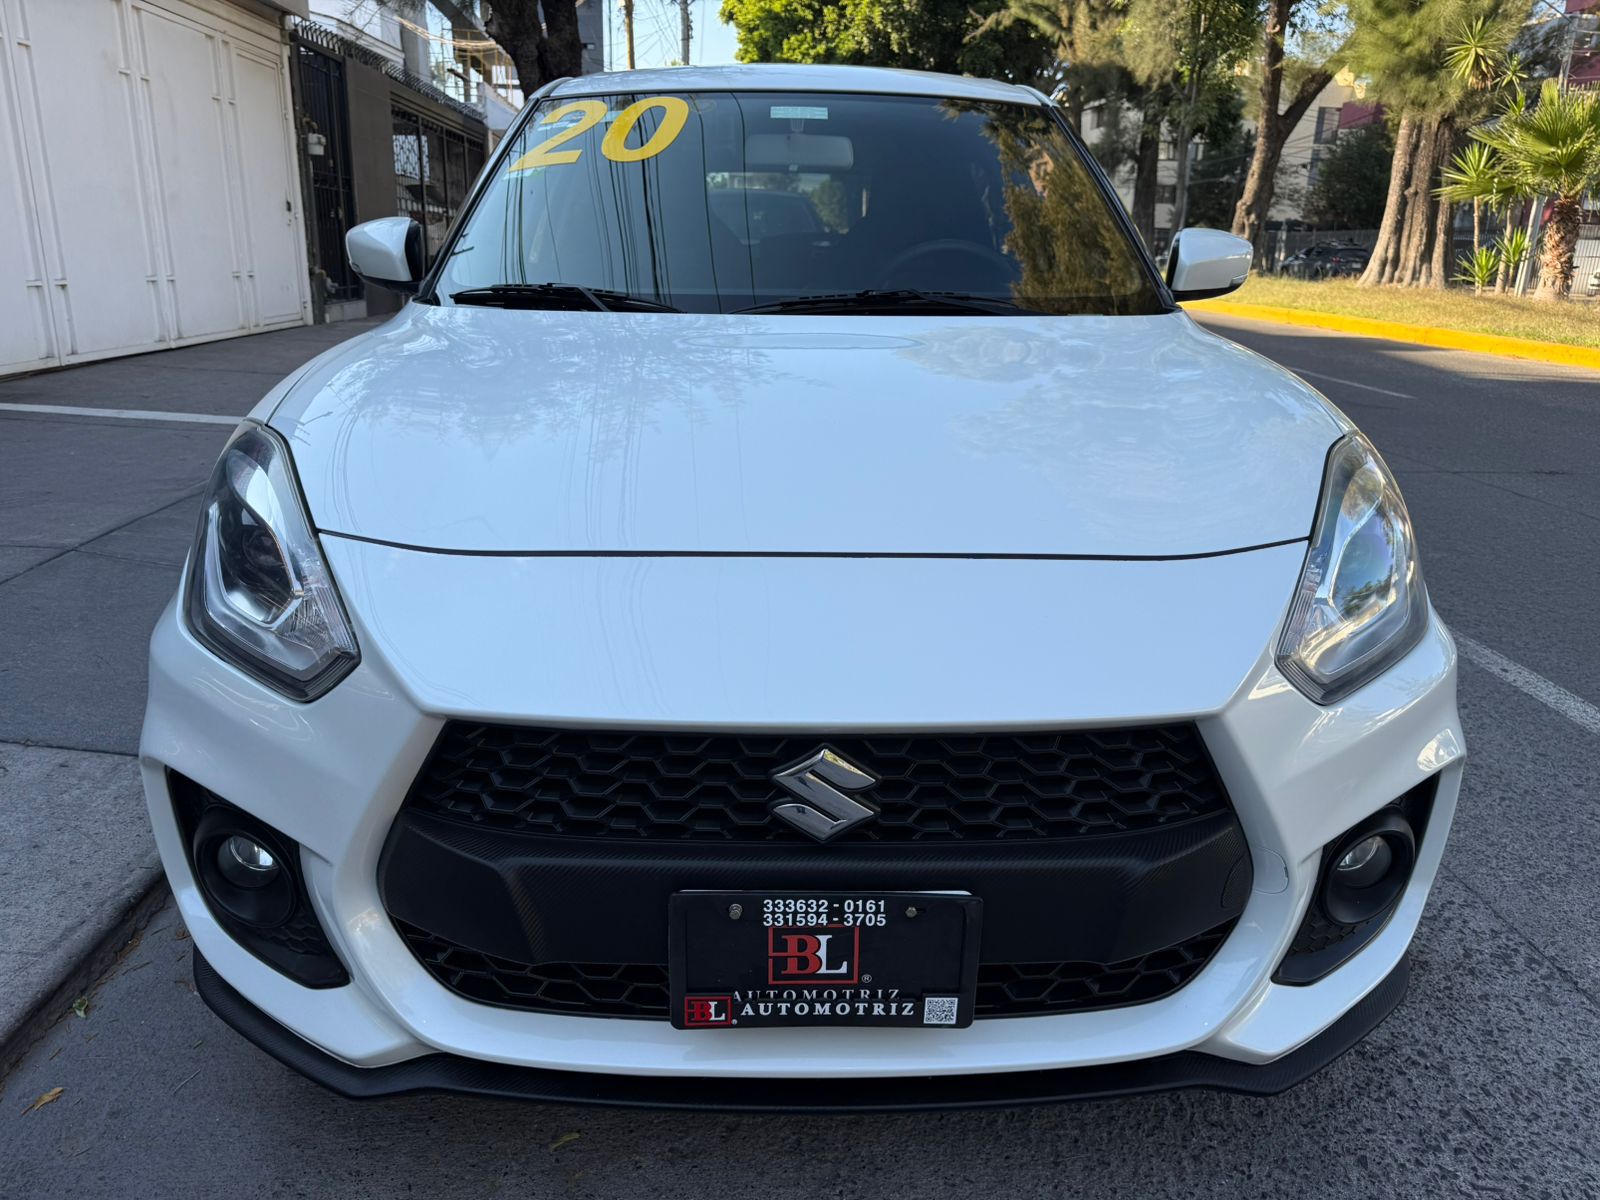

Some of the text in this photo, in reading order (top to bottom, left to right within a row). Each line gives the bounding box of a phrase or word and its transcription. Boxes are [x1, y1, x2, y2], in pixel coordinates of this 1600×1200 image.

[508, 96, 690, 172] 20
[780, 934, 848, 975] BL
[733, 989, 900, 1002] AUTOMOTRIZ
[689, 1001, 914, 1021] BL AUTOMOTRIZ
